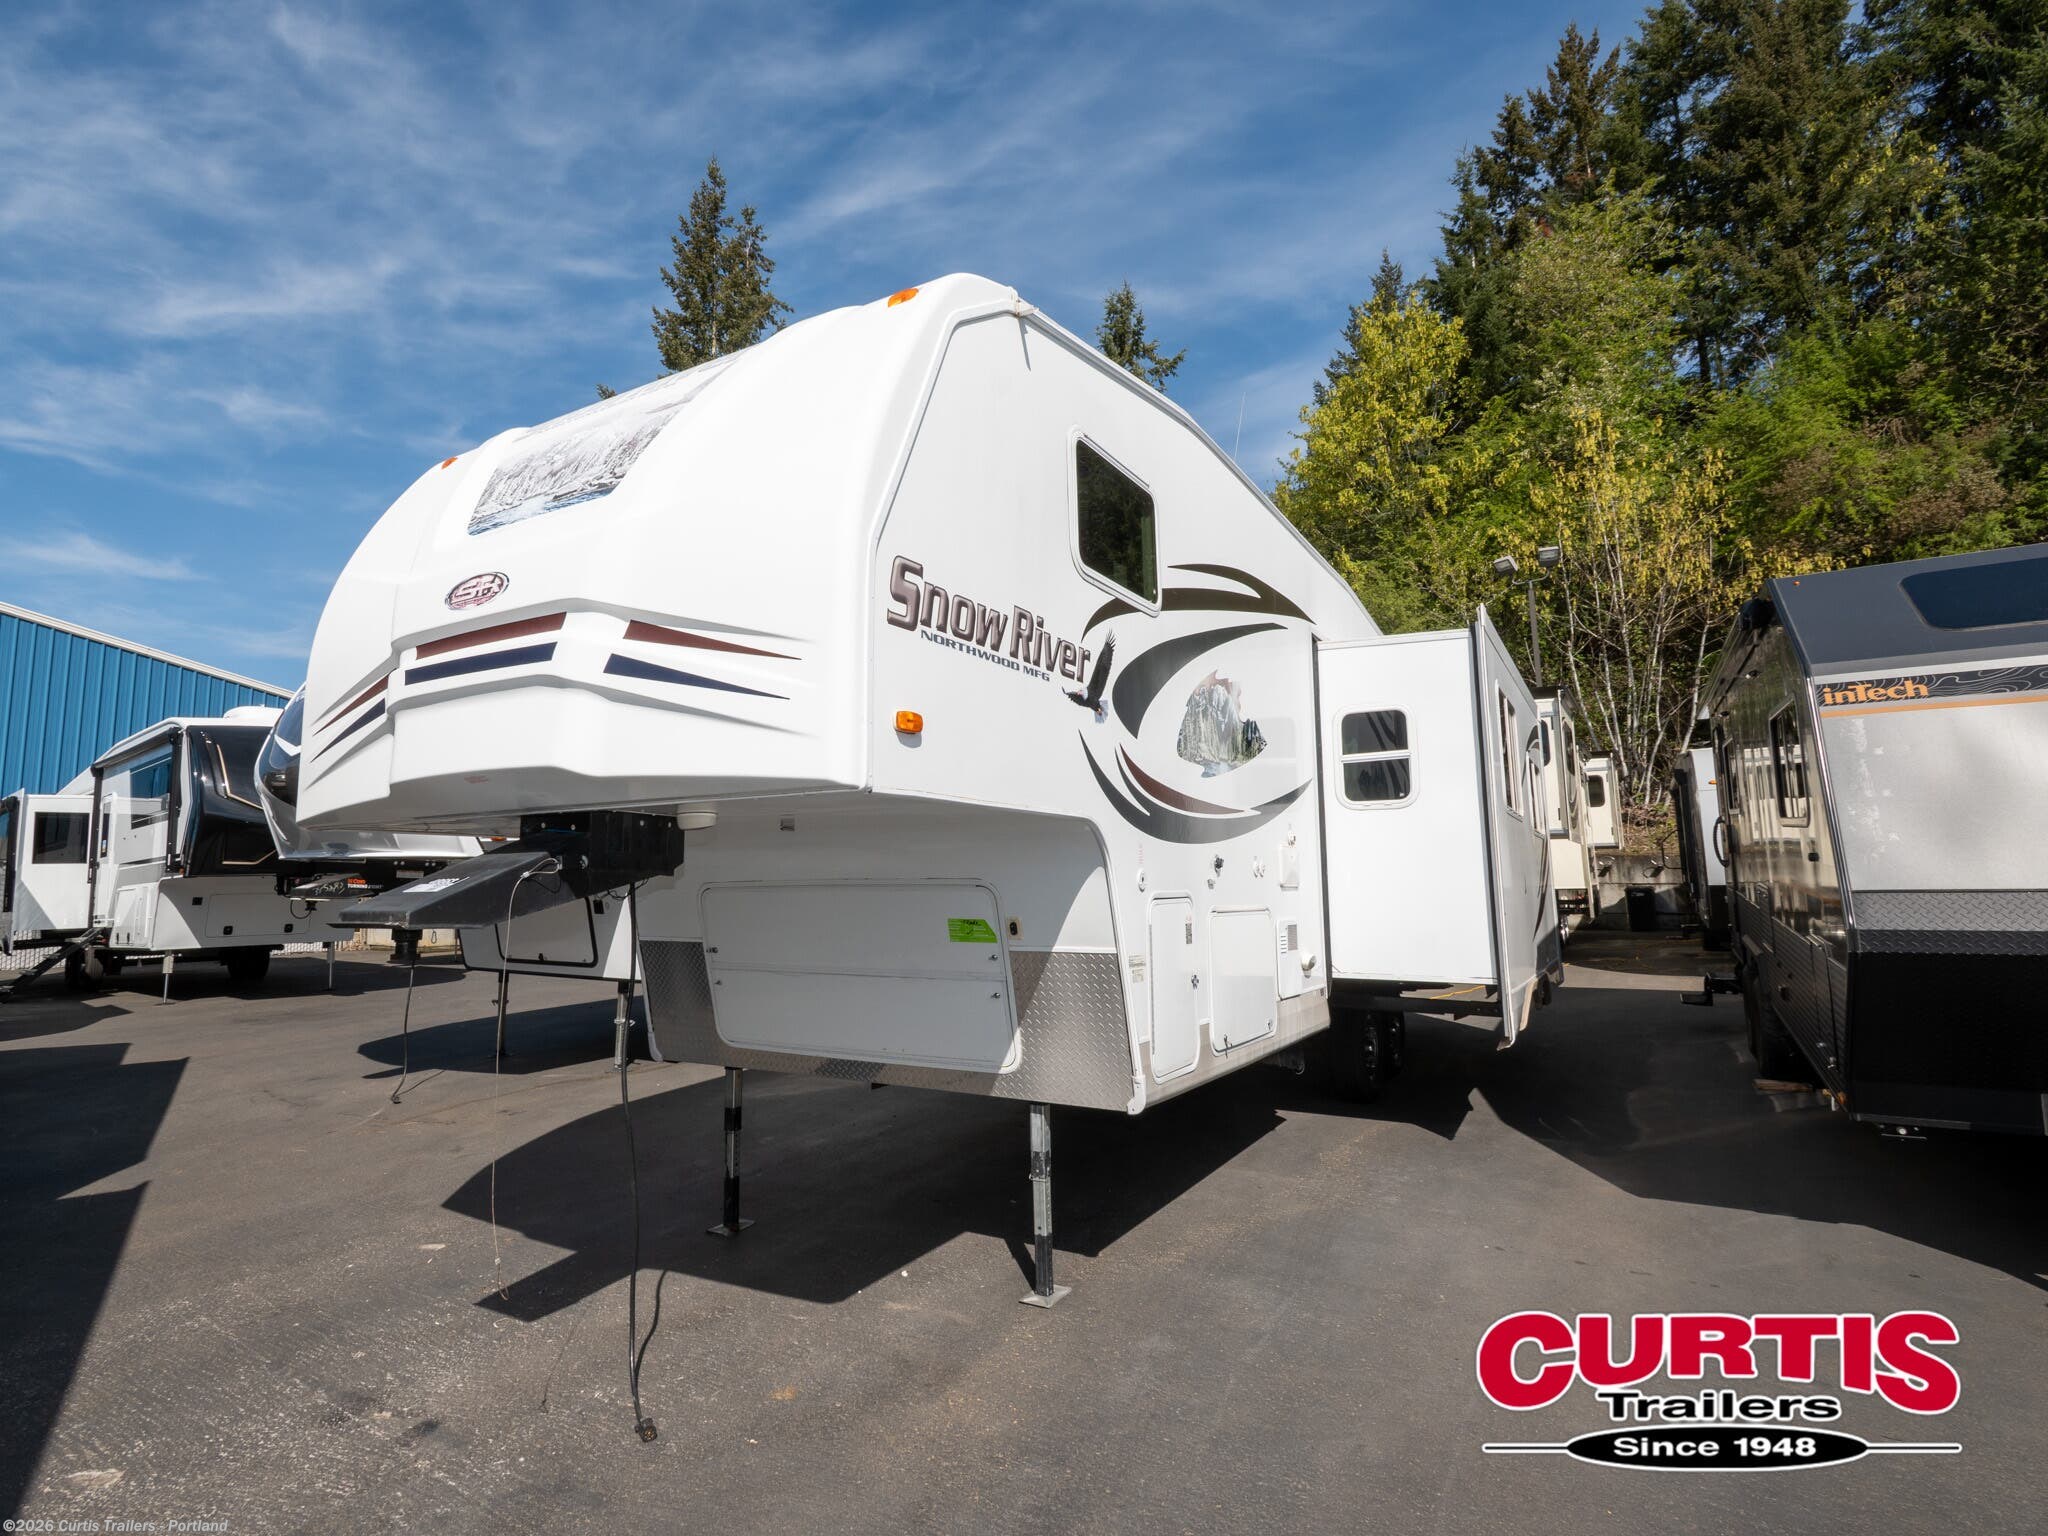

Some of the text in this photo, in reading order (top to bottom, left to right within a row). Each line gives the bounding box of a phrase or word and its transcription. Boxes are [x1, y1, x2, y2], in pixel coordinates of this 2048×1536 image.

[887, 555, 1091, 684] Snow River
[920, 629, 1050, 682] NORTHWOOD MFG
[1823, 680, 1929, 705] inTech
